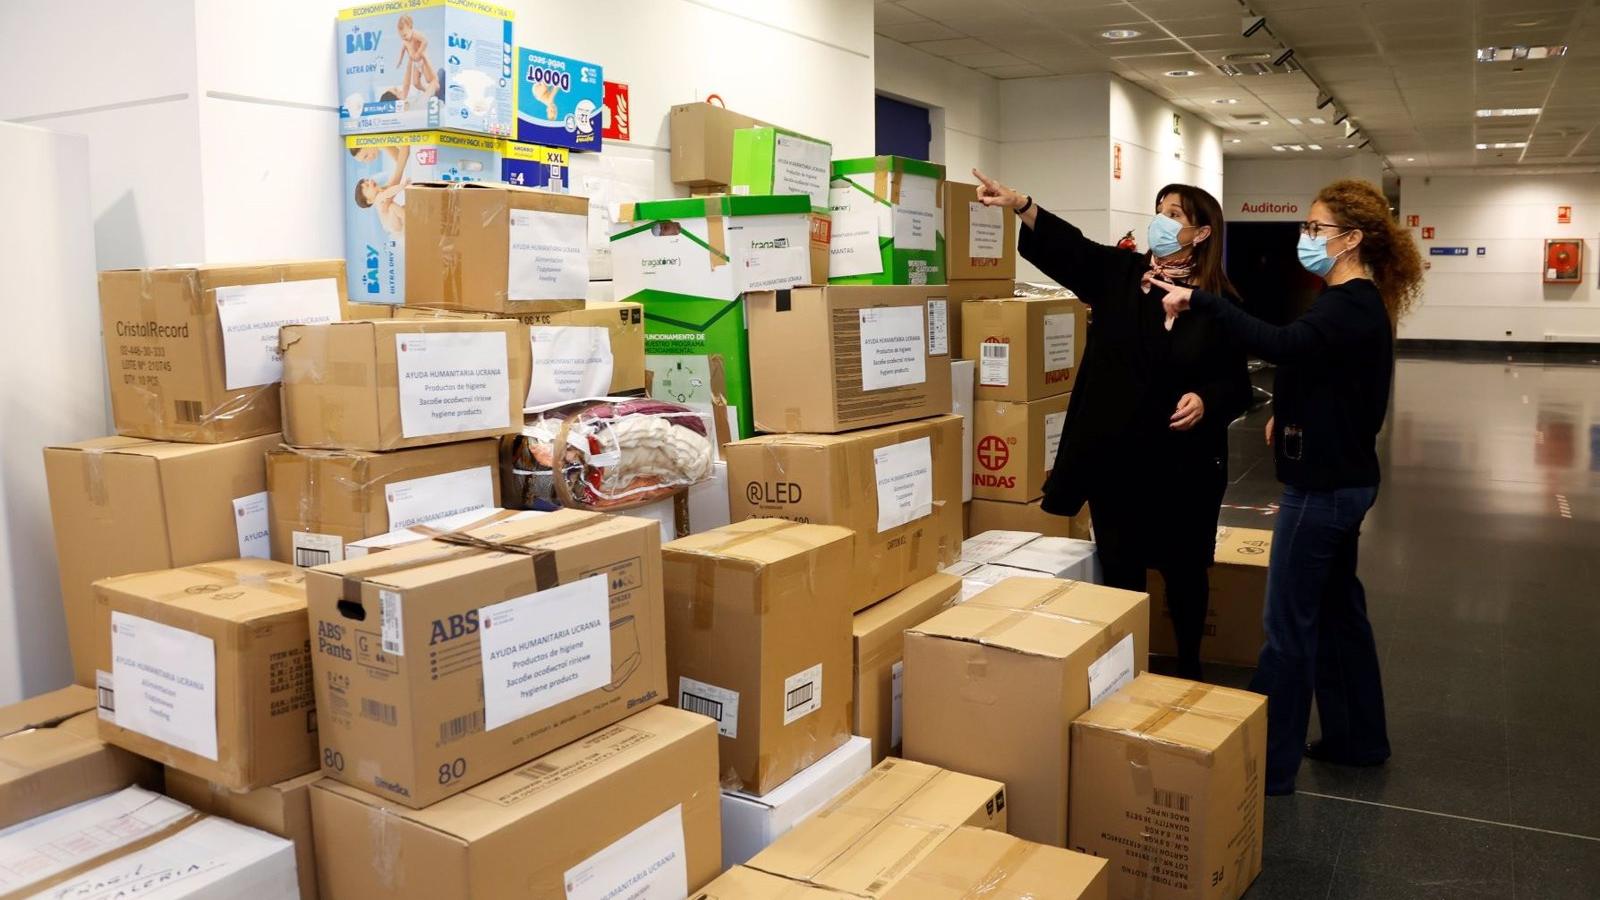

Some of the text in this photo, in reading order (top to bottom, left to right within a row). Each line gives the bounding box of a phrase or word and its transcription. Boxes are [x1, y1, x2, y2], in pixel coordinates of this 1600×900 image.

[346, 29, 382, 54] BABY
[448, 35, 473, 51] BABY
[528, 65, 569, 91] DODOT
[547, 152, 564, 163] XXL
[1241, 202, 1298, 213] Auditorio
[366, 245, 380, 294] BABY
[116, 320, 188, 338] CristalRecord
[226, 324, 252, 332] AYUDA
[405, 368, 501, 379] AYUDA HUMANITARIA UCRANIA
[424, 384, 456, 392] Productos
[466, 383, 487, 392] higiene
[432, 410, 482, 420] hygiene products
[394, 517, 416, 529] AYUDA
[416, 510, 458, 525] HUMANITARIA
[244, 530, 270, 543] AYUDA
[430, 608, 480, 646] ABS
[319, 638, 352, 661] Pants
[358, 636, 368, 652] G
[489, 618, 602, 661] AYUDA HUMANITARIA UCRANIA
[512, 640, 584, 670] Productos de higiene
[506, 672, 533, 689] Засоби
[534, 660, 569, 679] особистої
[520, 672, 578, 700] hygiene products
[324, 748, 344, 772] 80
[438, 758, 467, 785] 80
[1170, 812, 1190, 823] MADE
[648, 852, 676, 874] UCRANIA
